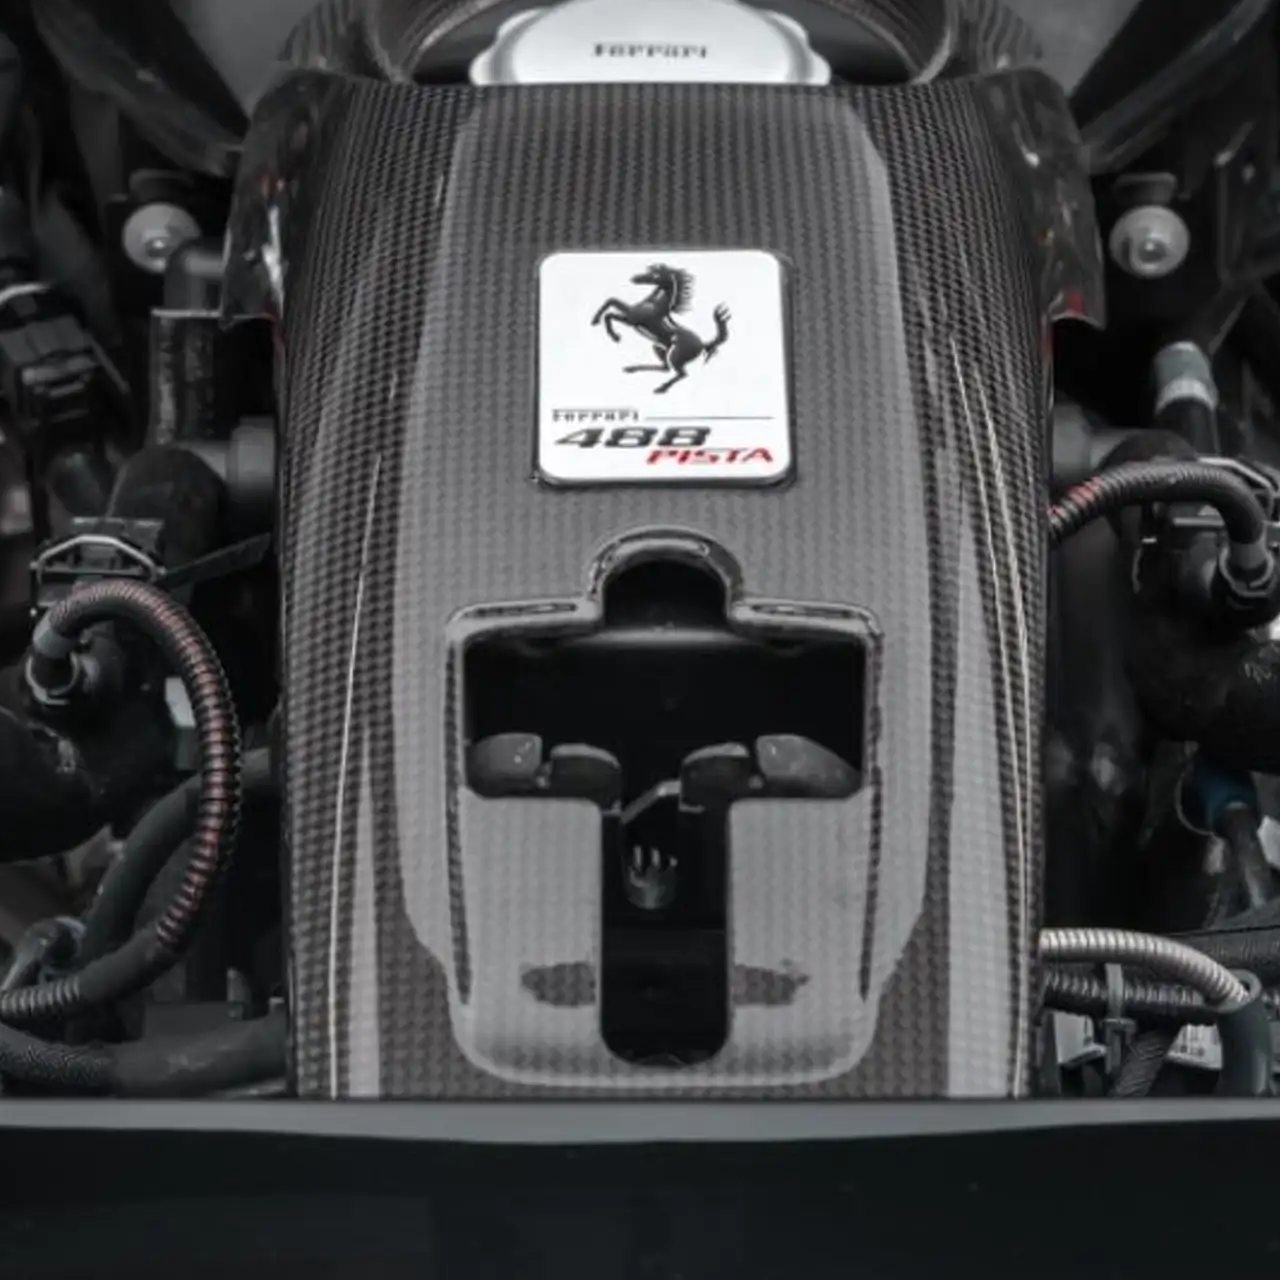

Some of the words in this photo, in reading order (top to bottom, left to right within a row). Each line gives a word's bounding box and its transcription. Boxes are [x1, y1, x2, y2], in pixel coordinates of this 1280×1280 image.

[593, 42, 707, 59] Ferrari
[552, 408, 639, 423] Ferrari
[554, 425, 711, 448] 488
[646, 448, 774, 465] PISTA
